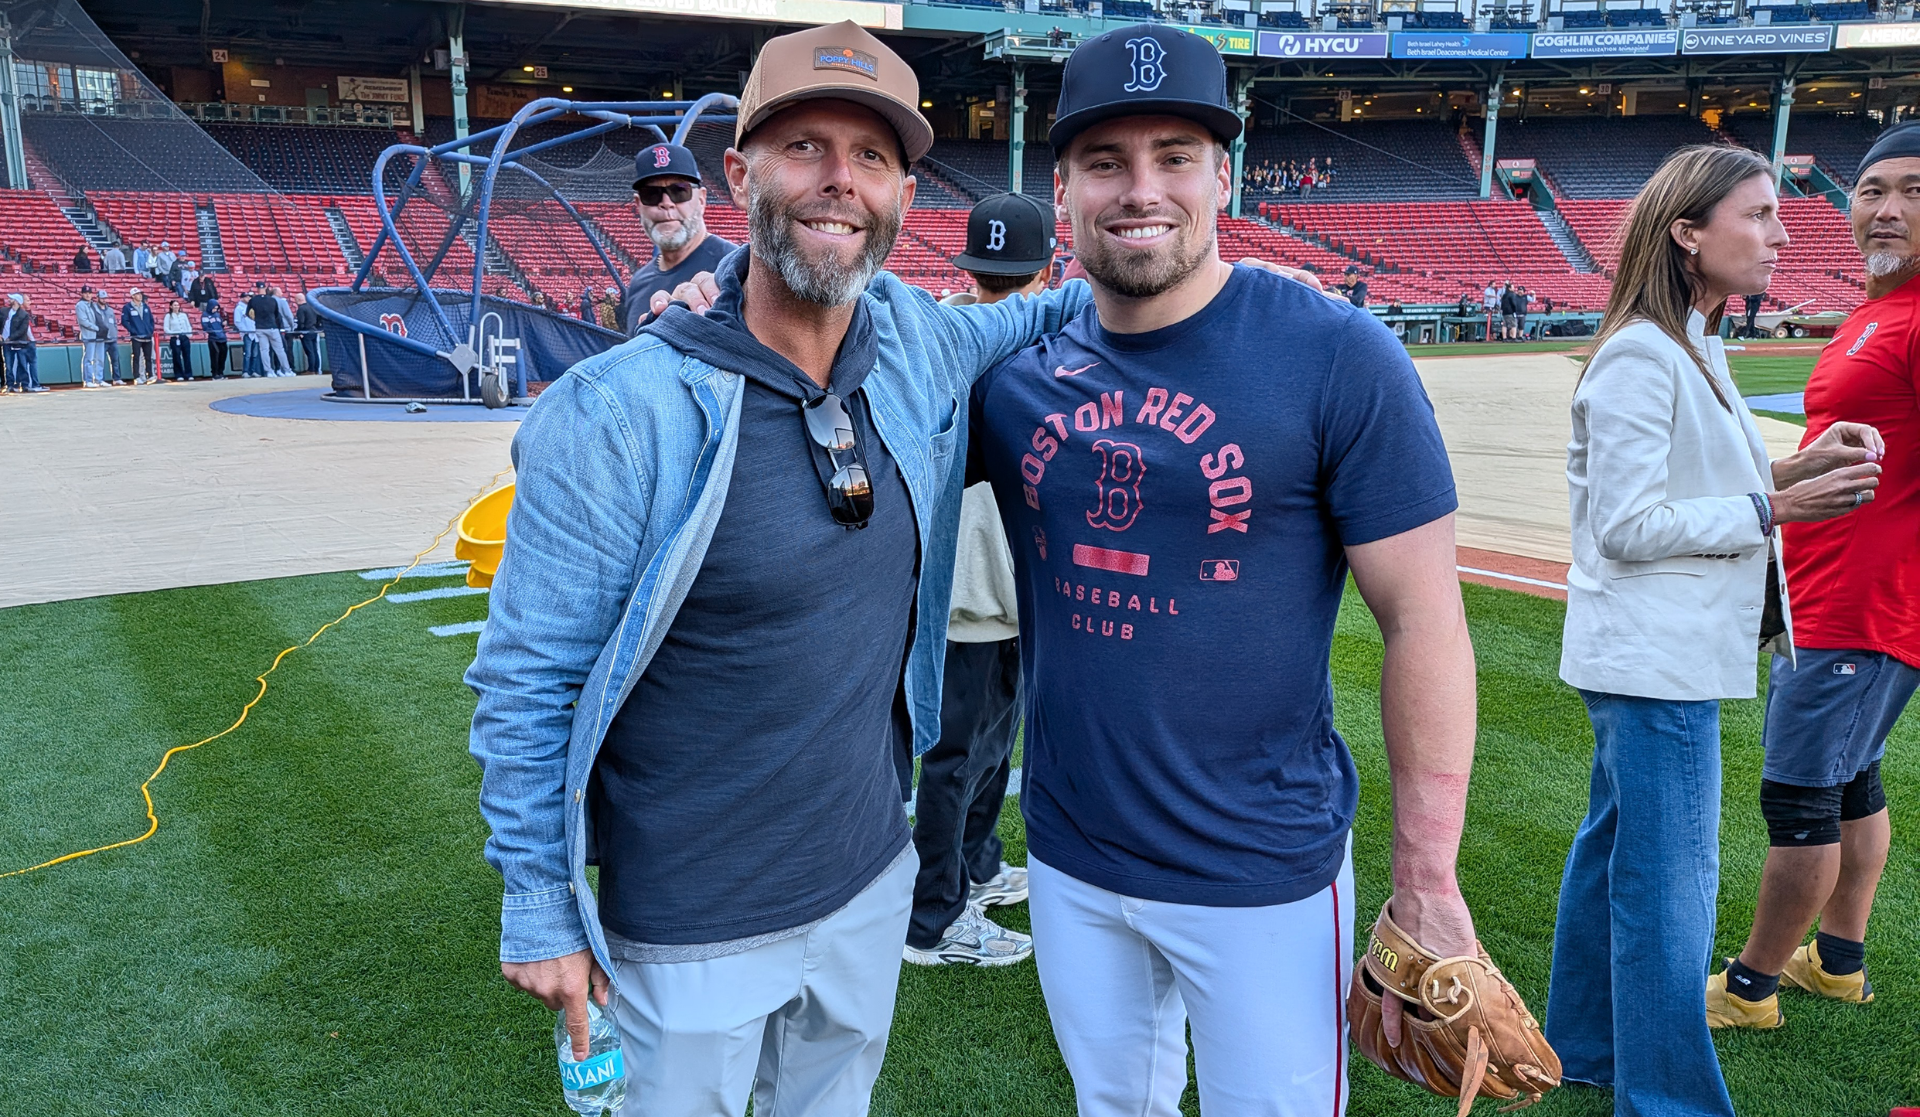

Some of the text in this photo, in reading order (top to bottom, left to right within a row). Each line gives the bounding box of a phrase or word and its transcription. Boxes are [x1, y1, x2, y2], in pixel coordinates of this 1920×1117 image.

[699, 0, 777, 16] BALLPARK
[1228, 36, 1251, 50] TIRE
[1304, 37, 1360, 53] HYCU
[1535, 32, 1676, 47] COGHLIN COMPANIES
[1700, 32, 1826, 46] VINEYARD VINES
[214, 51, 227, 61] 24
[1407, 48, 1420, 56] Beth
[820, 55, 849, 64] POPPY
[851, 58, 874, 72] HILLS
[1124, 37, 1168, 92] B
[535, 67, 546, 77] 25
[652, 146, 671, 168] B
[986, 219, 1007, 251] B
[1021, 387, 1252, 534] BOSTON RED SOX
[1086, 438, 1147, 532] B
[1055, 576, 1179, 616] BASEBALL
[1071, 613, 1134, 640] CLUB
